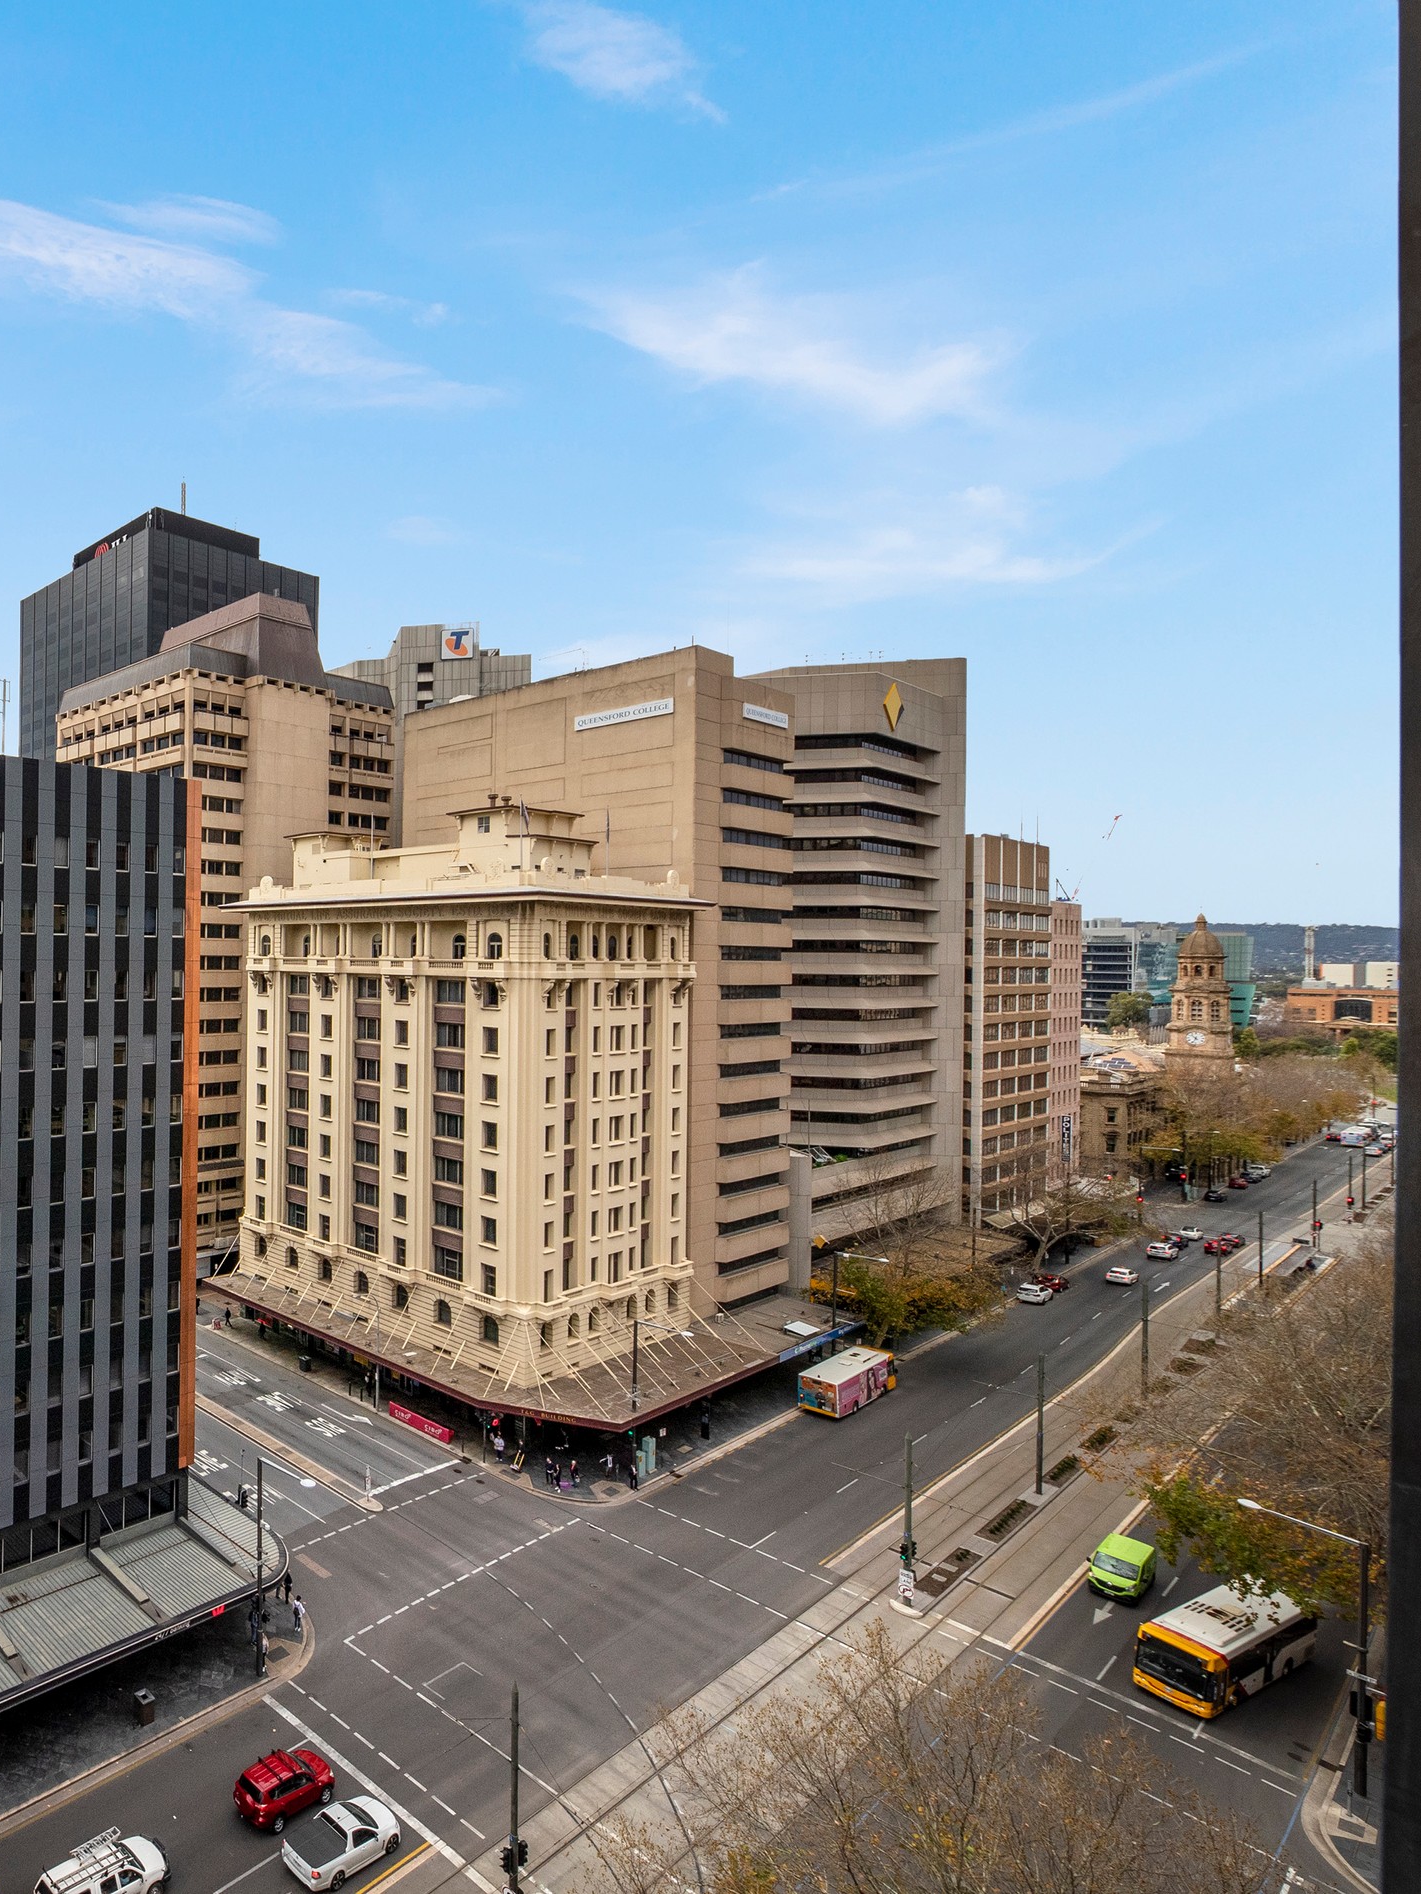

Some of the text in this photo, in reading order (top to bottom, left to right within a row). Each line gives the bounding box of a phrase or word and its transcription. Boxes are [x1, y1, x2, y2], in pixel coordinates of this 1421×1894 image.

[577, 702, 670, 727] QUEENSFORD COLLEGE
[541, 1411, 577, 1423] BUILDING
